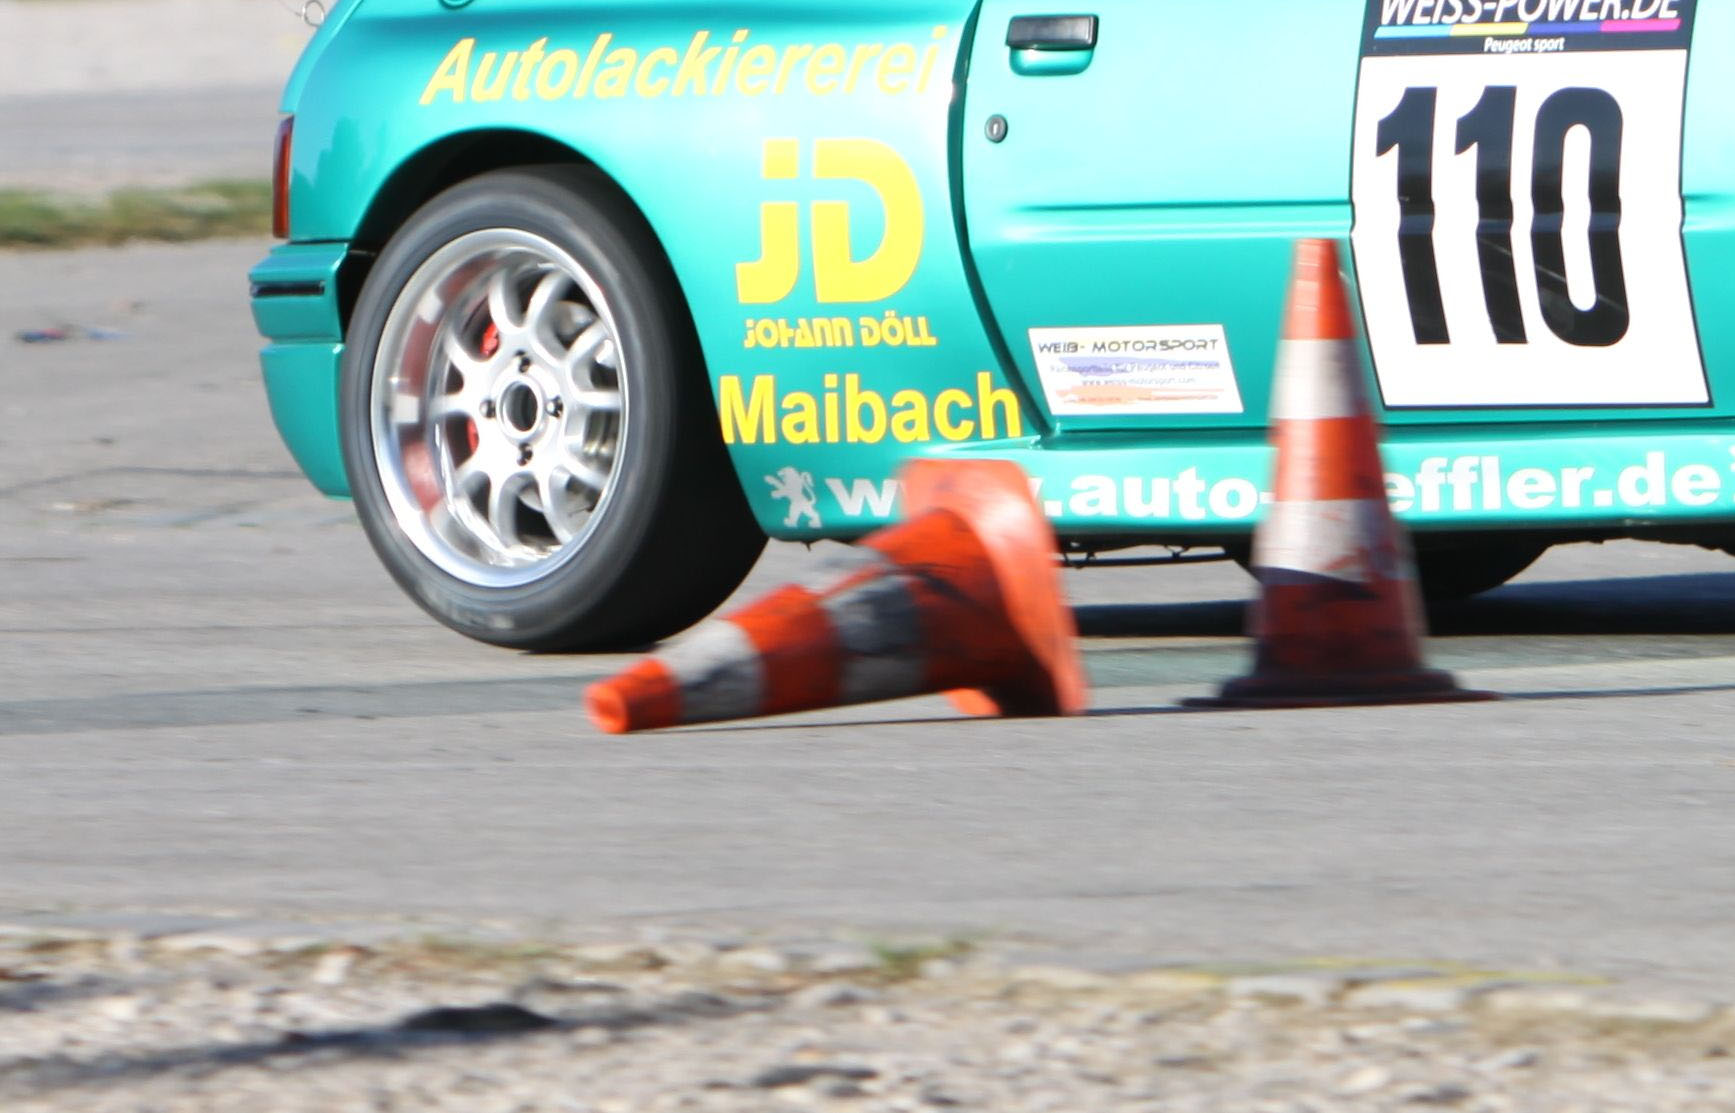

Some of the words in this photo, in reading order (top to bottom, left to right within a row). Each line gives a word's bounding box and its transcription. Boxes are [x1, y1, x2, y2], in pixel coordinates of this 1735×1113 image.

[418, 26, 948, 105] Autolackiererei
[1484, 37, 1532, 54] Peugeot
[1533, 36, 1566, 54] sport
[1375, 85, 1630, 347] 110
[1092, 339, 1218, 352] MOTORSPORT
[719, 371, 1022, 444] Maibach
